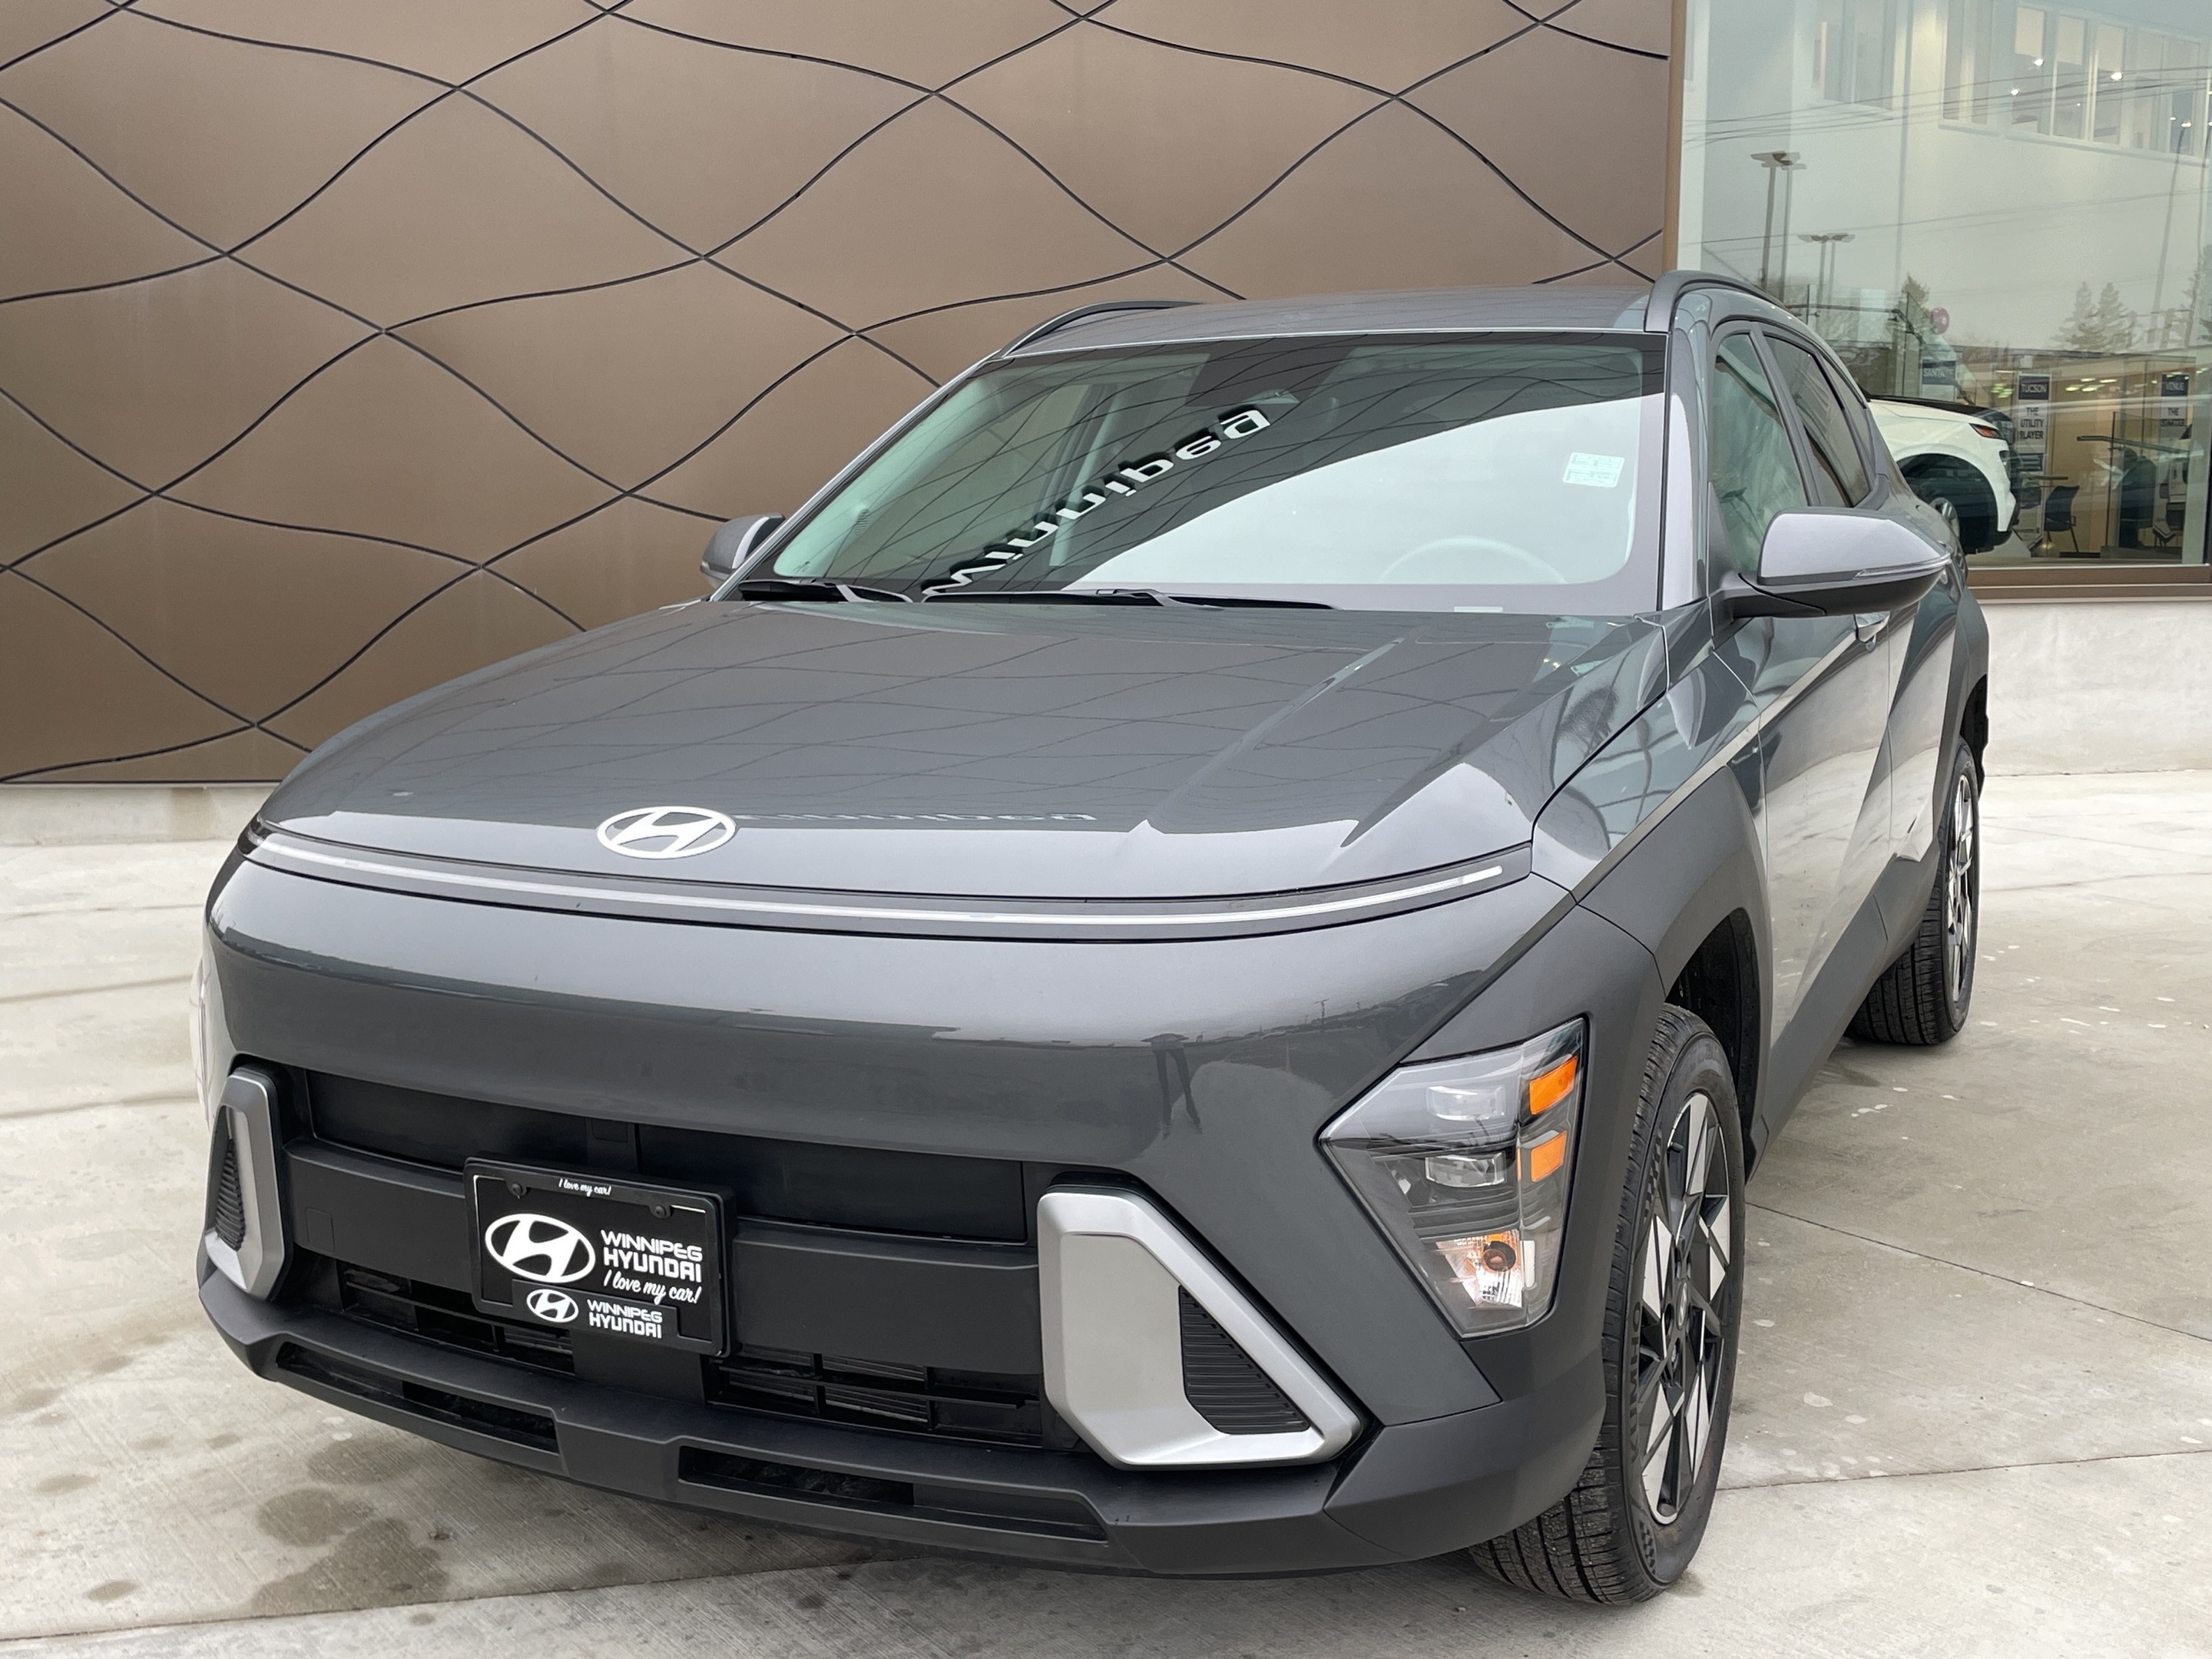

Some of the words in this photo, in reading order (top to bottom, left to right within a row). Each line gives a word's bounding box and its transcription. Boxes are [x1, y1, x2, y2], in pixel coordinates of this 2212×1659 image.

[1923, 369, 1945, 378] SANTA
[2021, 384, 2047, 393] TUCSON
[2020, 419, 2045, 428] UTILITY
[2026, 407, 2039, 416] THE
[558, 1178, 563, 1187] I
[564, 1179, 580, 1190] love
[580, 1184, 593, 1197] my
[594, 1185, 611, 1195] car!
[601, 1229, 703, 1262] WINNIPEG
[604, 1247, 701, 1283] HYUNDAI
[604, 1269, 612, 1286] I
[612, 1270, 641, 1293] love
[643, 1281, 667, 1305] my
[668, 1286, 702, 1304] car!
[587, 1299, 663, 1323] WINNIPEG
[589, 1312, 662, 1339] HYUNDAI
[1629, 1301, 1642, 1464] KUMHO
